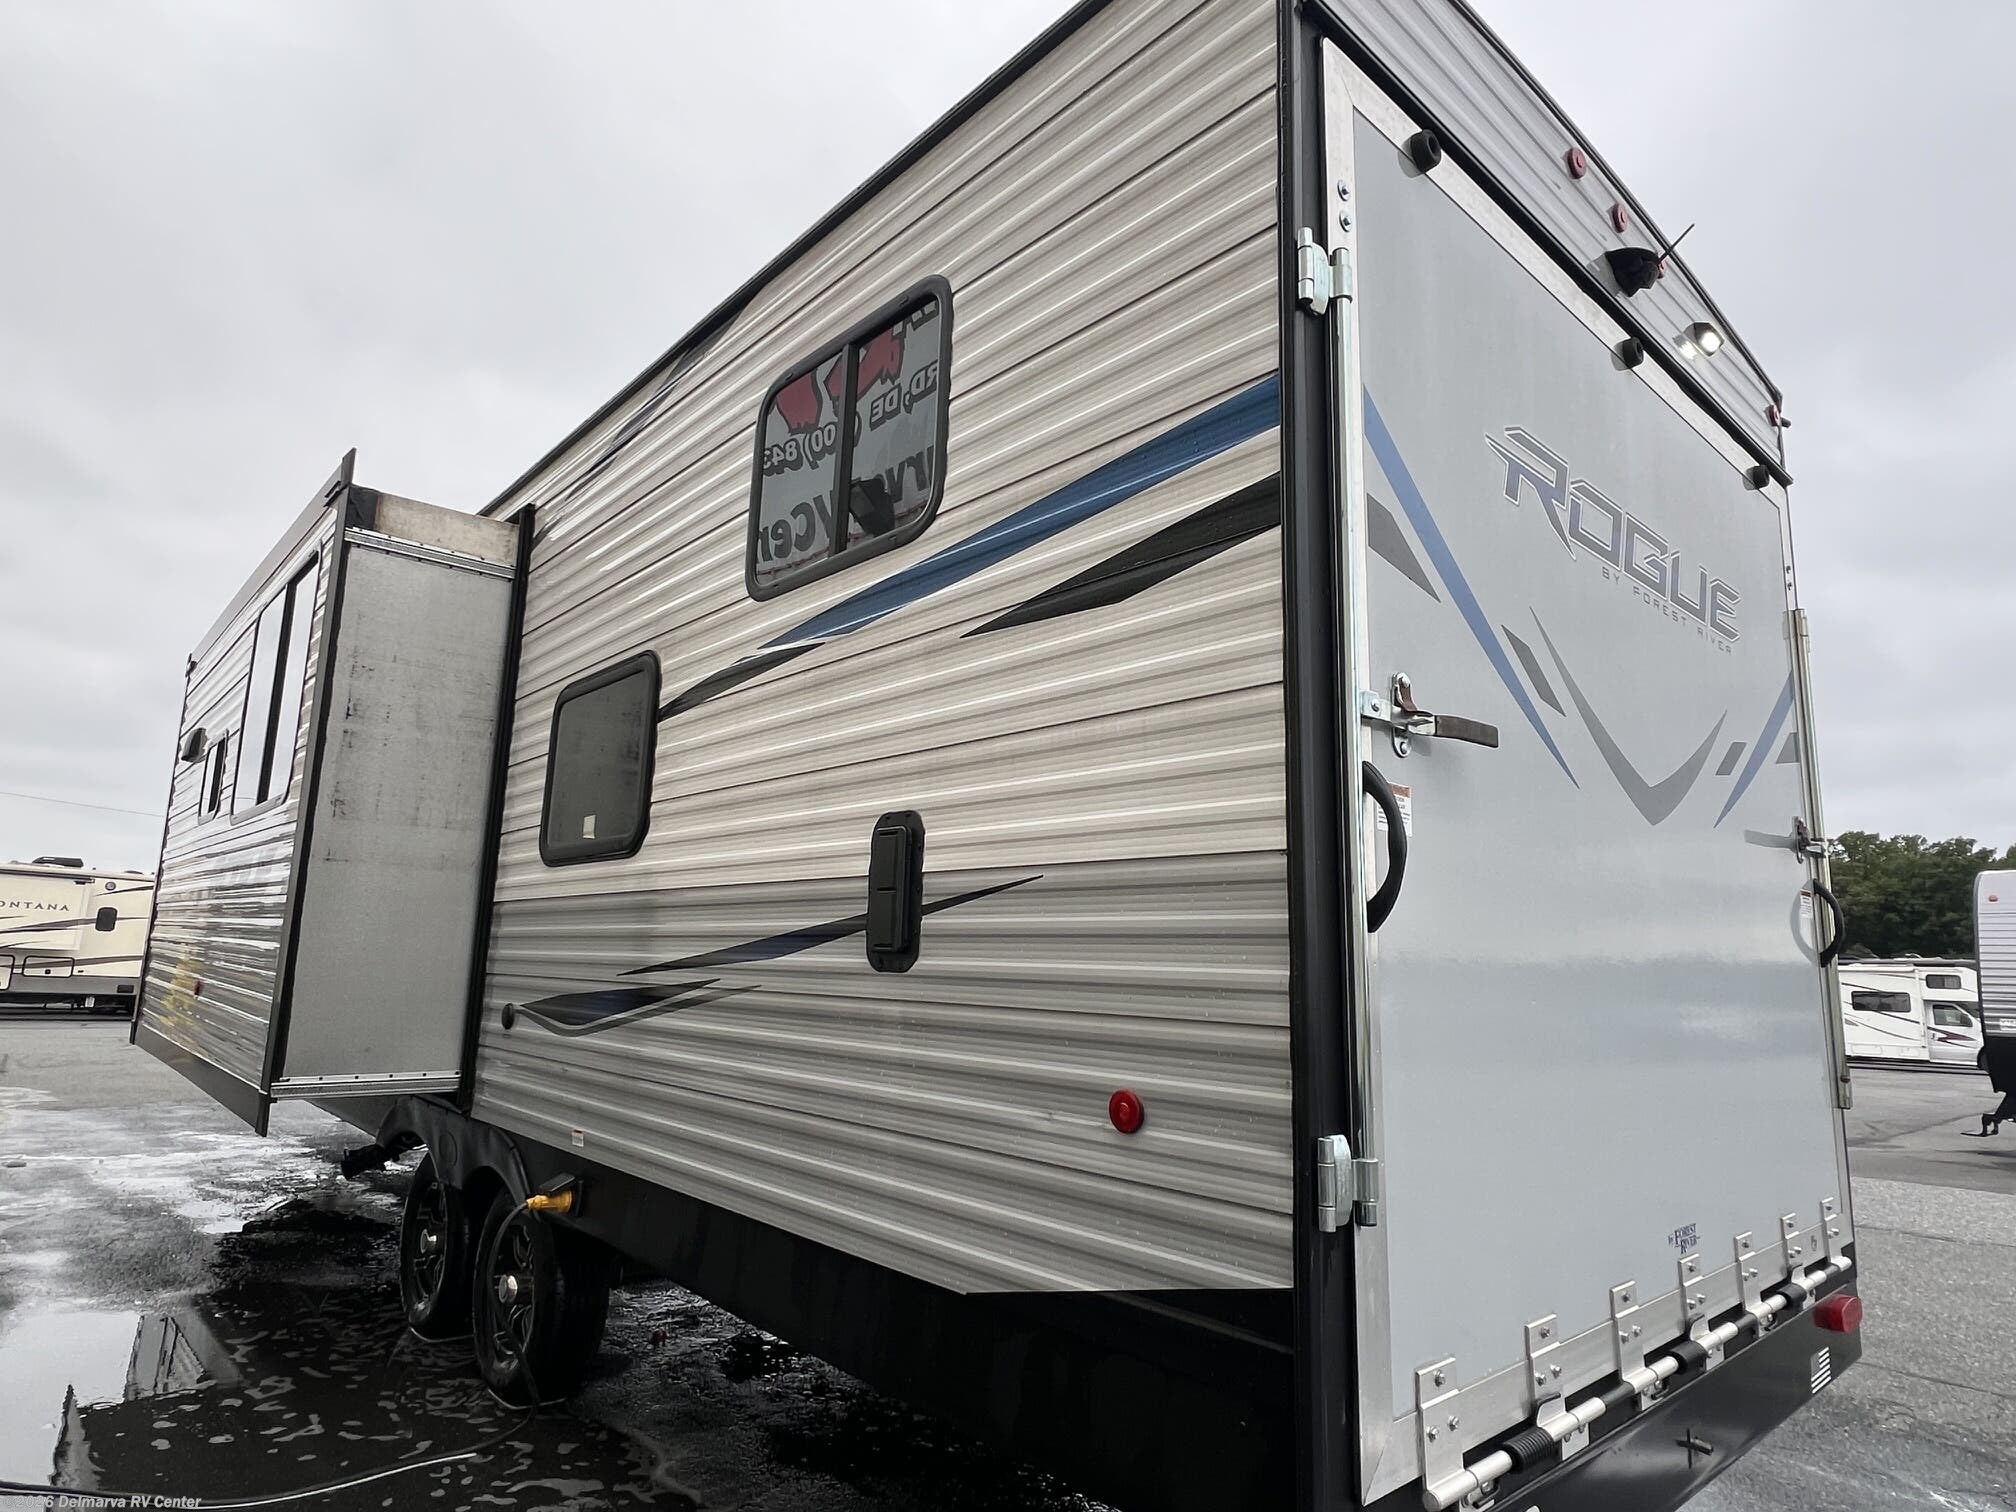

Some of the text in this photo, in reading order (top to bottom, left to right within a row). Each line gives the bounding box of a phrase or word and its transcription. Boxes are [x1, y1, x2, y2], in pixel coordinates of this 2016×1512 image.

[1484, 426, 1742, 642] ROGUE
[1601, 566, 1732, 654] BY FOREST RIVER
